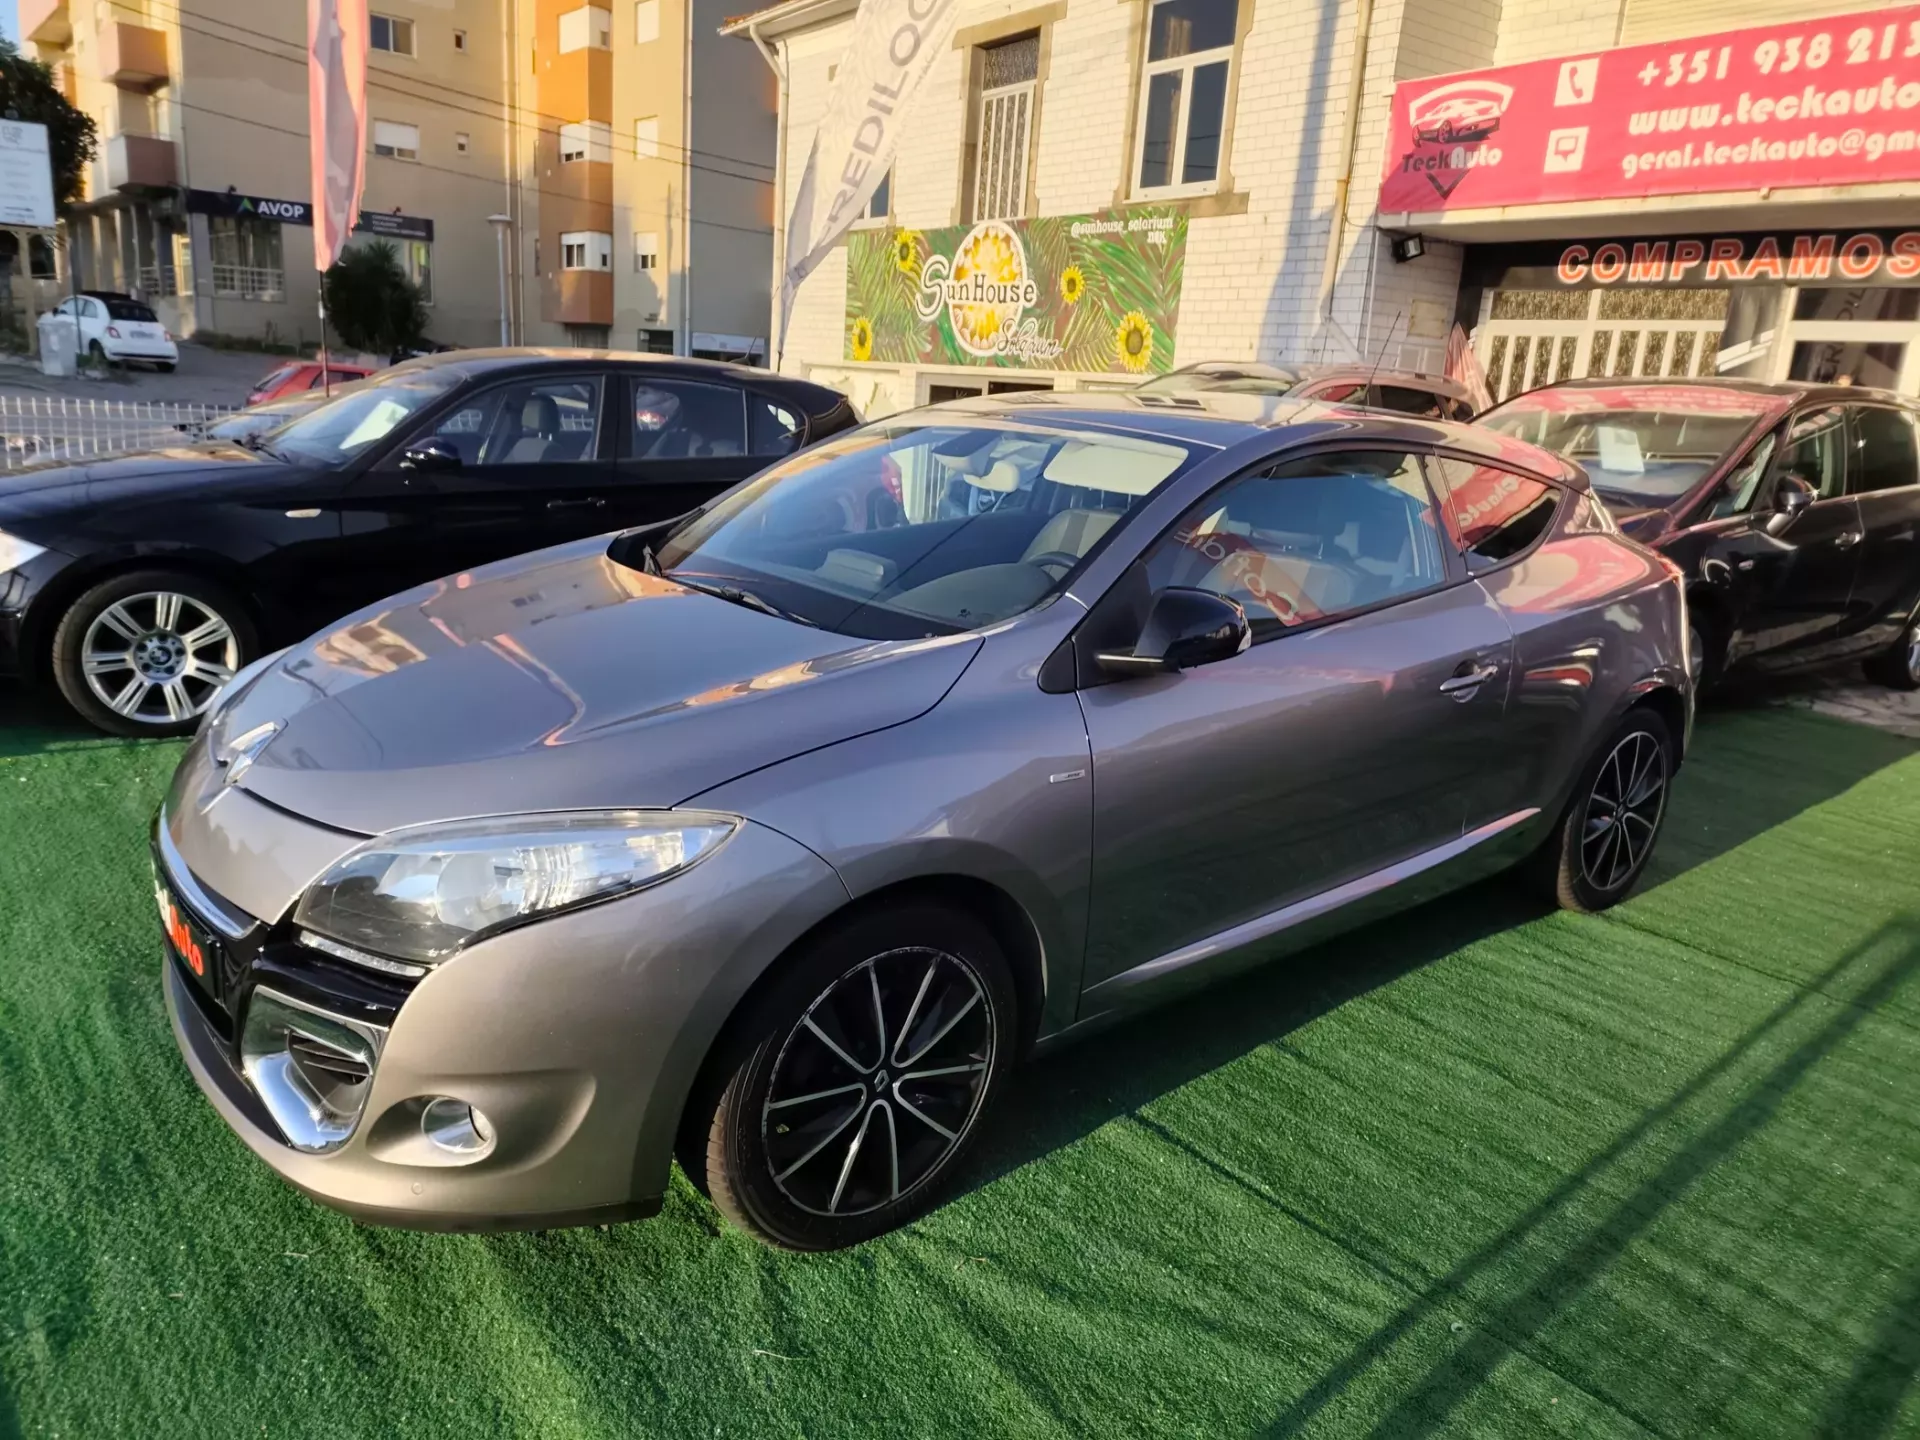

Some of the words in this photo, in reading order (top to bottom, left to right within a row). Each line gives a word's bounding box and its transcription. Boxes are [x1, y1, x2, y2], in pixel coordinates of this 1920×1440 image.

[1637, 46, 1732, 87] +351
[1753, 32, 1833, 75] 938
[1845, 20, 1920, 65] 213
[1621, 128, 1920, 180] geral.teckauto@gm
[258, 201, 304, 218] AVOP
[1556, 231, 1920, 285] COMPRAMOS
